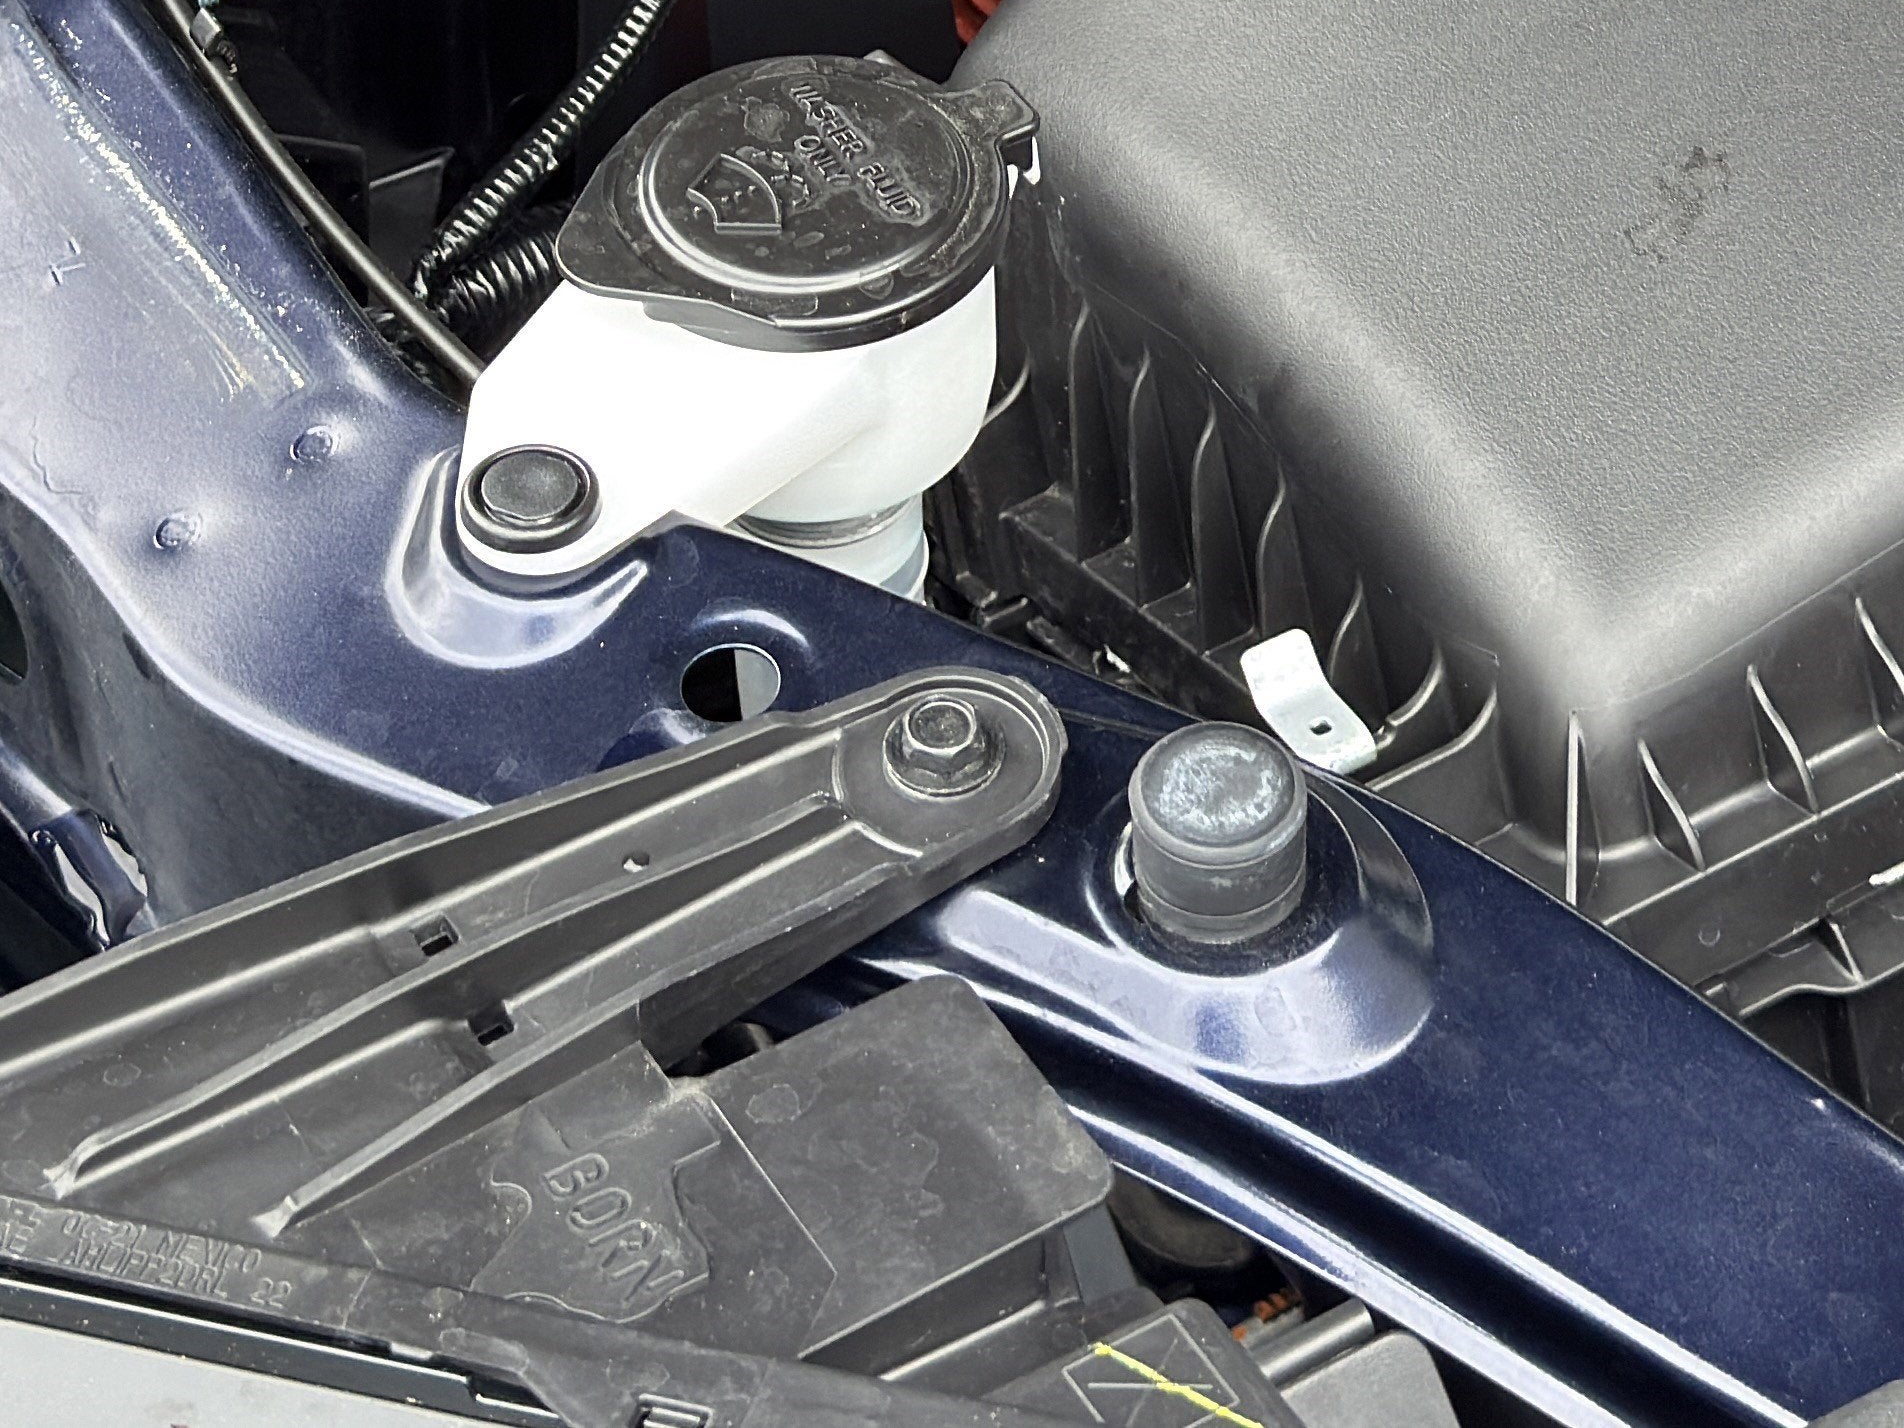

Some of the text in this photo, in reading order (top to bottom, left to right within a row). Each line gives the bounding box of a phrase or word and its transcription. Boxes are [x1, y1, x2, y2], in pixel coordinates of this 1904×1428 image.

[794, 135, 853, 184] ONLY
[857, 161, 922, 218] FLUID
[541, 1151, 686, 1304] BORN
[250, 1277, 293, 1309] 22
